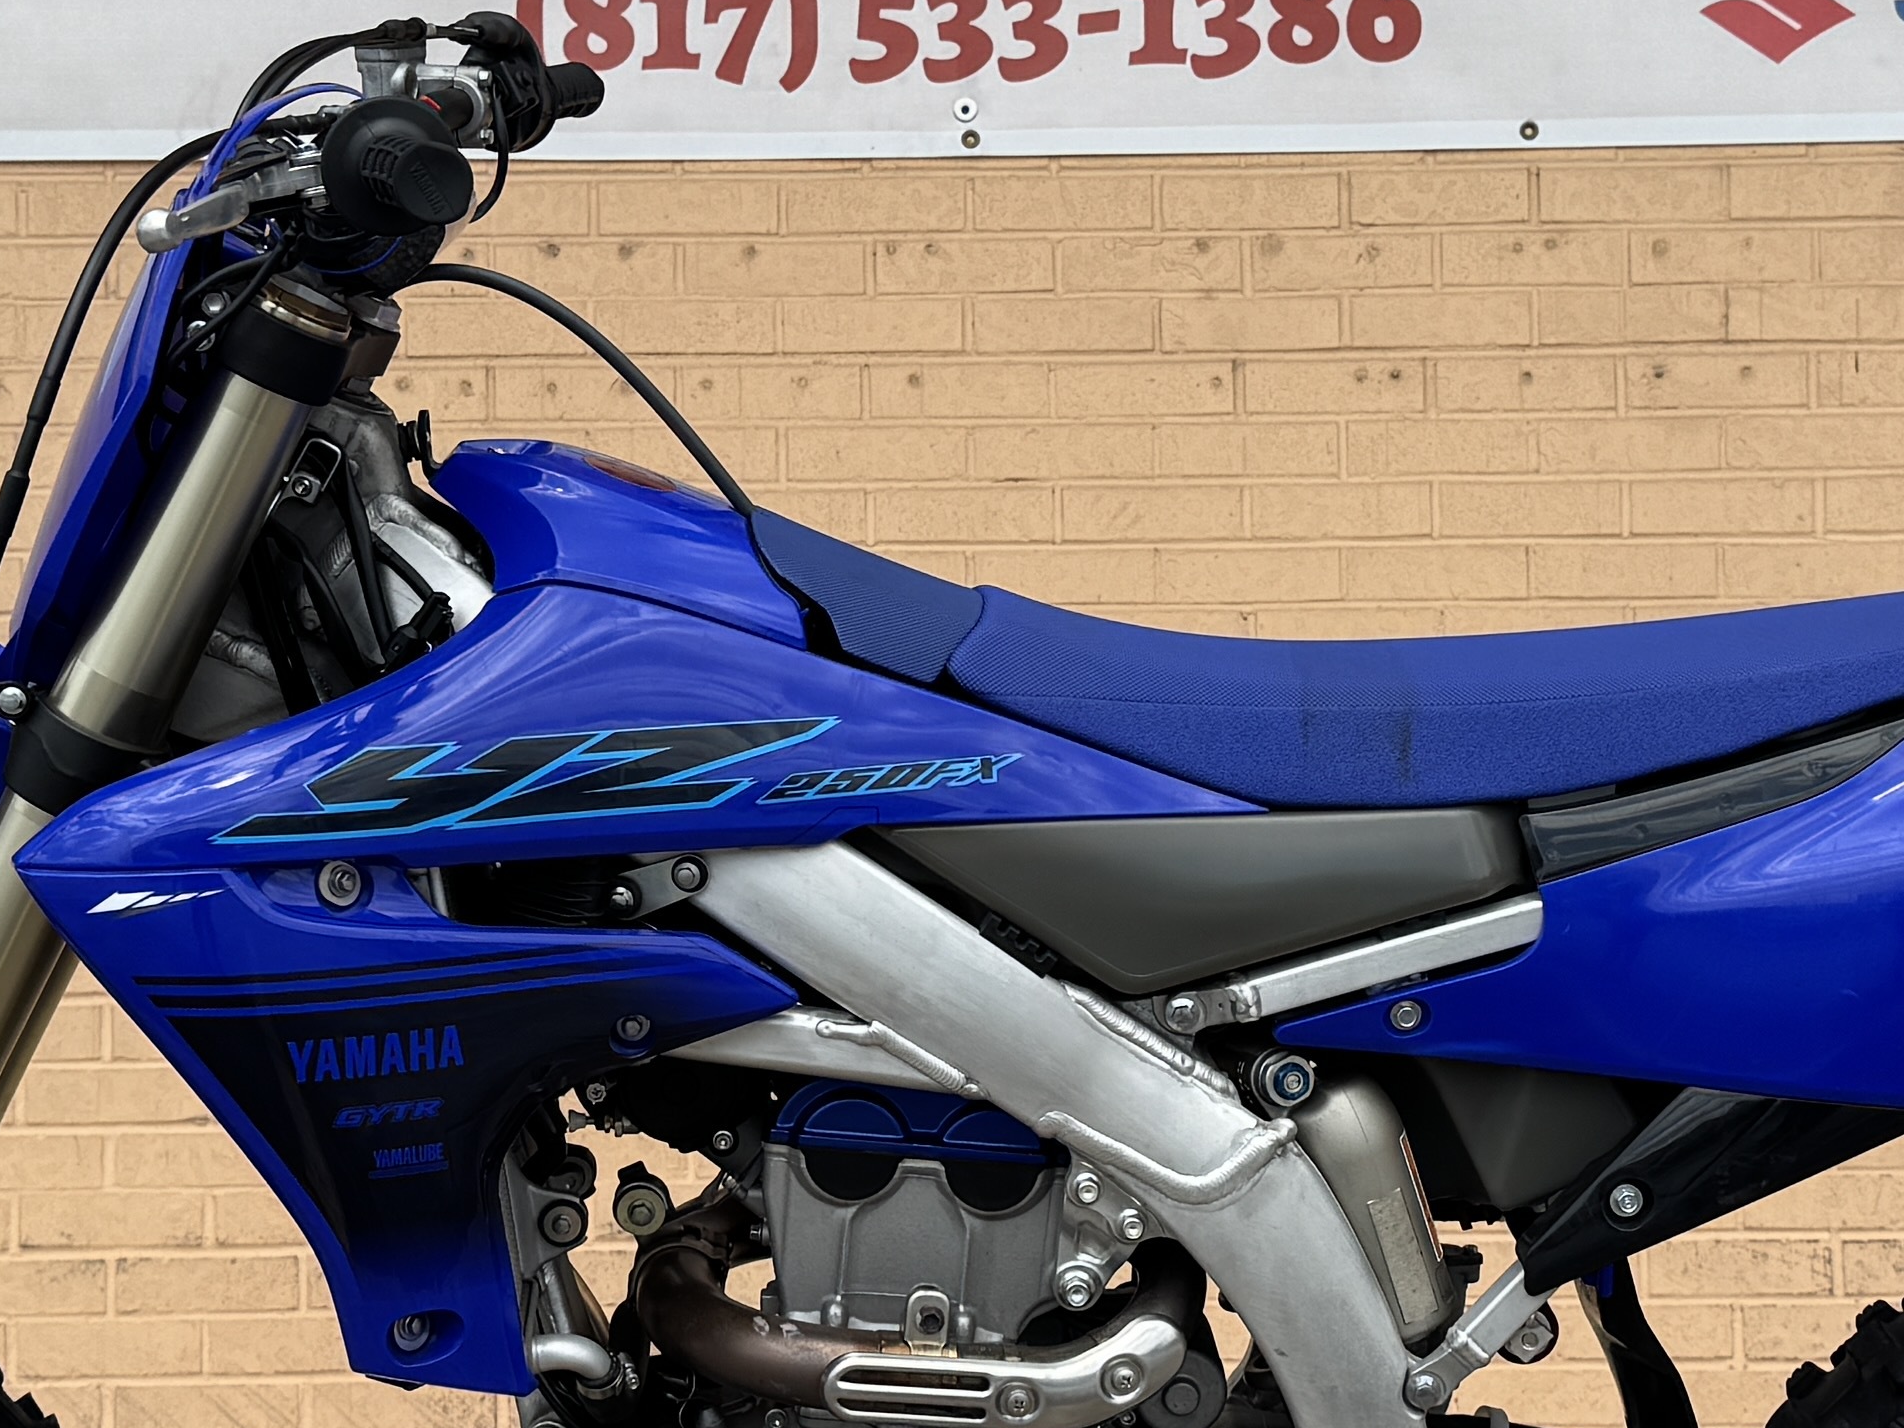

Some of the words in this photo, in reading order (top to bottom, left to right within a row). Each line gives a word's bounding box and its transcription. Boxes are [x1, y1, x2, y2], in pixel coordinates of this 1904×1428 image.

[209, 715, 841, 844] YZ
[755, 752, 1026, 805] 250FX
[286, 1024, 465, 1084] YAMAHA
[332, 1096, 445, 1129] GYTR
[373, 1142, 445, 1168] YAMALUBE
